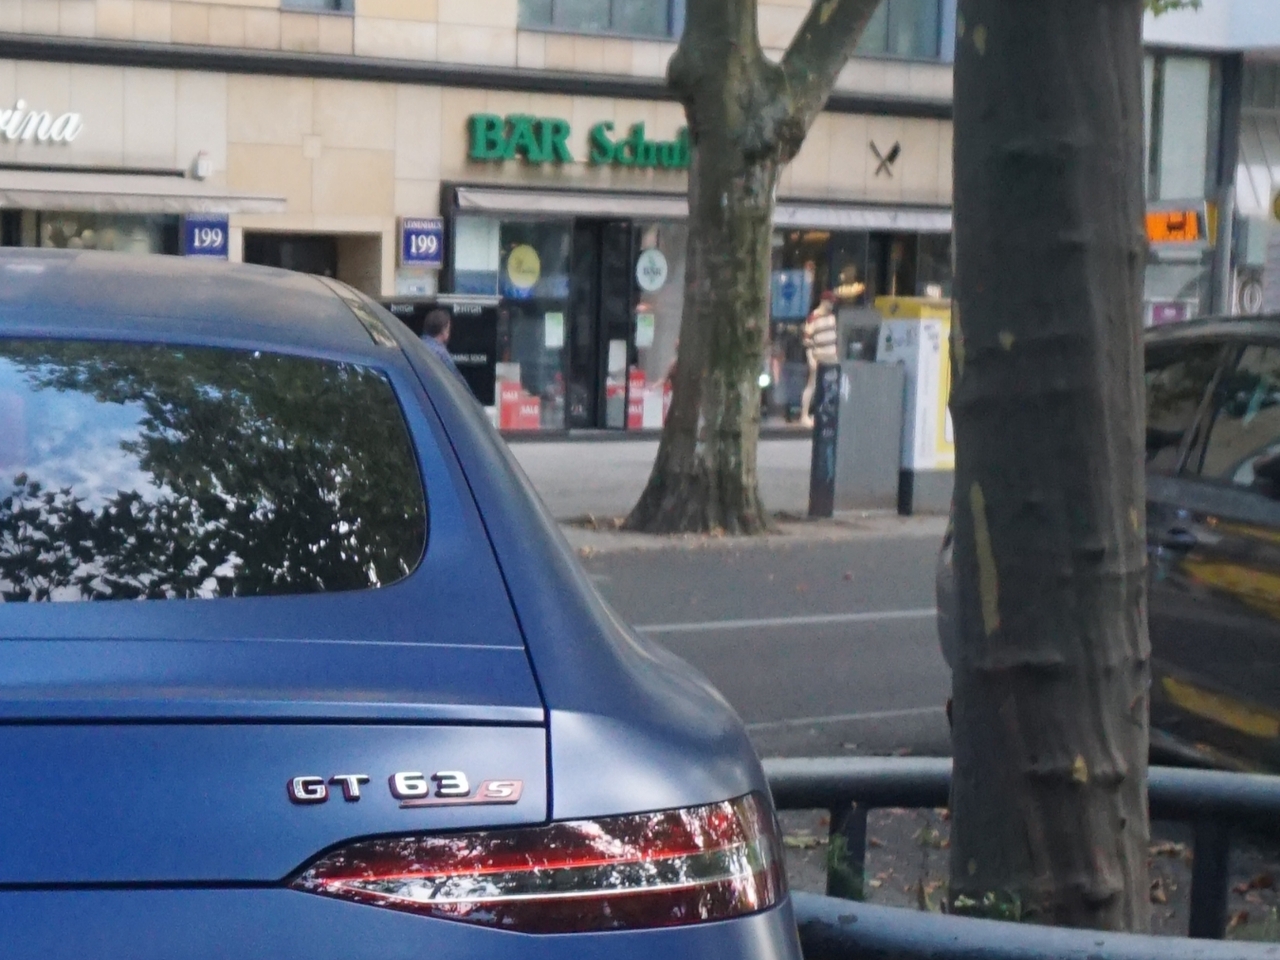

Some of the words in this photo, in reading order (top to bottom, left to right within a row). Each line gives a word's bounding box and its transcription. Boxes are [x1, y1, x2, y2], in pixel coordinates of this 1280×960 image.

[193, 228, 223, 247] 199
[410, 234, 437, 254] 199
[287, 774, 370, 803] GT
[388, 770, 471, 800] 63
